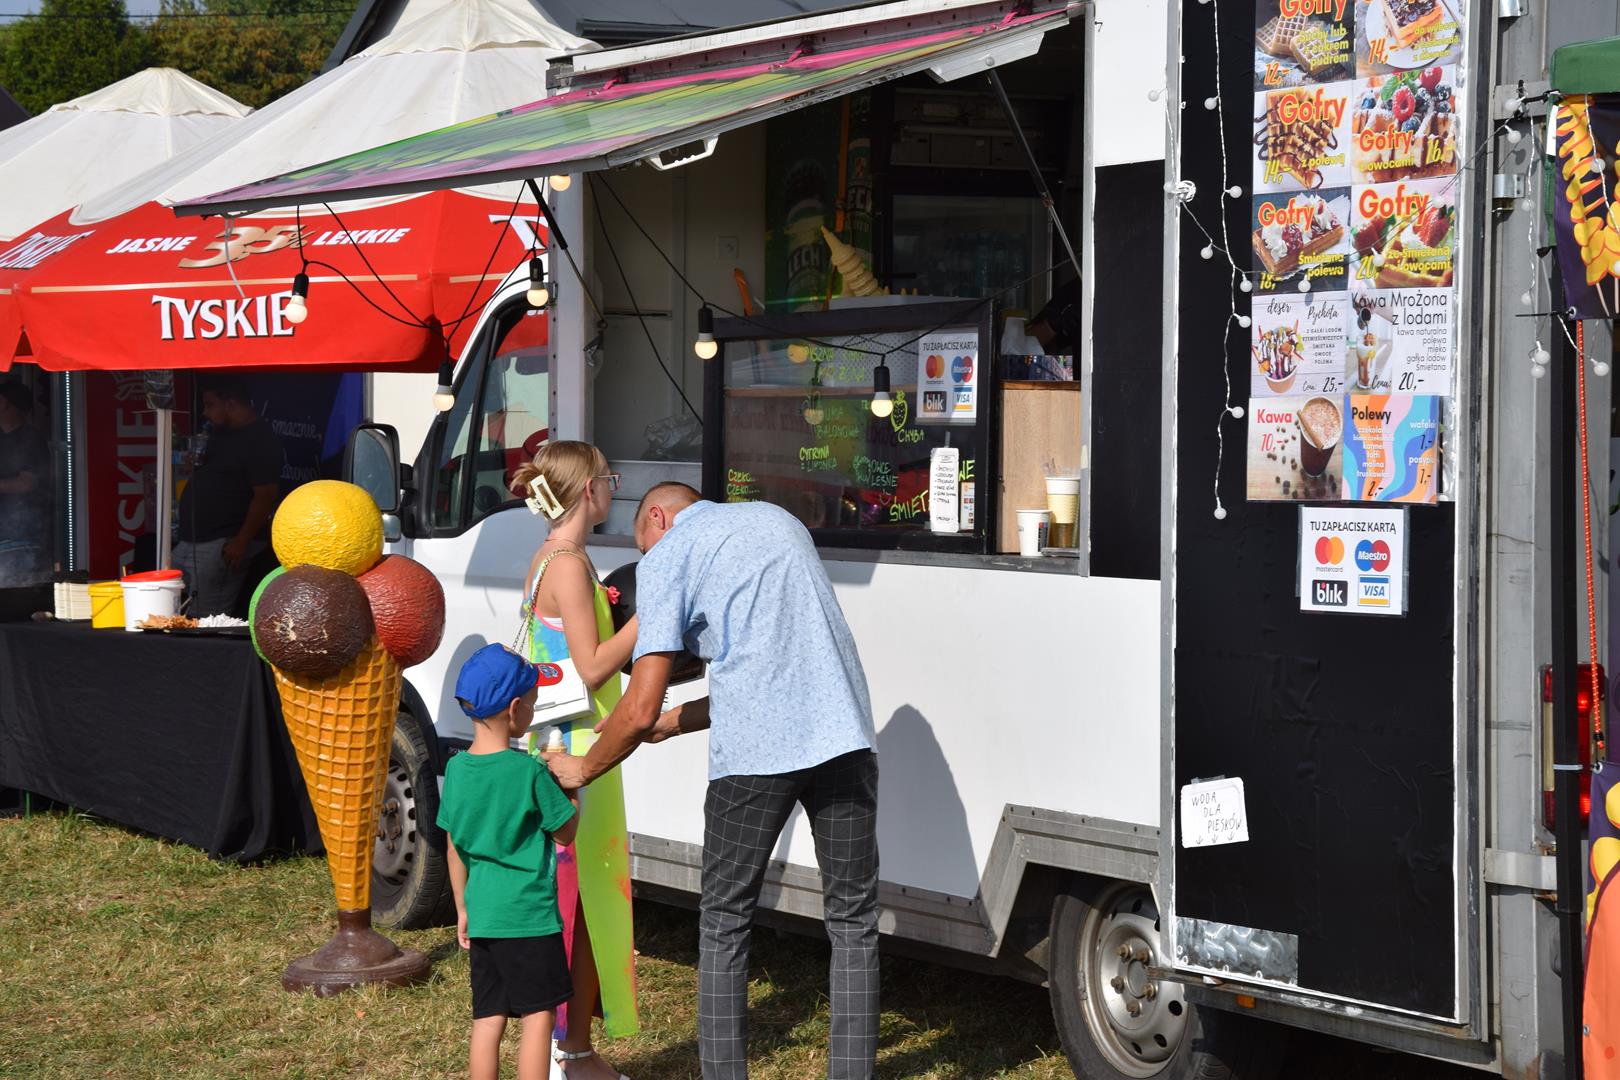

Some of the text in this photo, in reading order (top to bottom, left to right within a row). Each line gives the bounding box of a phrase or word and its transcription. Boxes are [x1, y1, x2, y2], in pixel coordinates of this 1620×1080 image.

[1331, 23, 1347, 37] lub
[1312, 40, 1349, 53] cukrem
[1368, 37, 1400, 64] 14,-
[1310, 53, 1349, 71] pudrem
[1278, 88, 1347, 128] Gofry
[1359, 123, 1414, 155] Gofry
[1368, 156, 1414, 171] owocami
[1263, 160, 1292, 184] 14,-
[1359, 184, 1430, 226] Gofry
[1258, 197, 1315, 232] Gofry
[106, 235, 198, 254] JASNE
[311, 227, 411, 246] LEKKIE
[1308, 265, 1344, 280] polewa
[1403, 260, 1453, 271] owocami
[1351, 292, 1386, 308] Kawa
[152, 290, 295, 341] TYSKIE
[1307, 301, 1338, 325] Pychota
[1391, 307, 1447, 326] z lodami
[1396, 327, 1447, 336] kawa naturalna
[923, 342, 931, 351] TU
[931, 341, 959, 351] ZAPŁACISZ
[1422, 336, 1447, 347] polewa
[1427, 343, 1447, 353] mleko
[1322, 376, 1344, 393] 25,-
[1398, 371, 1425, 392] 20,-
[926, 393, 944, 411] blik
[956, 393, 970, 403] VISA
[1257, 408, 1292, 424] Kawa
[1351, 405, 1392, 425] Polewy
[897, 428, 925, 443] CHYBA
[799, 445, 829, 461] CYTRYNA
[1367, 480, 1384, 497] 2,-
[1310, 521, 1397, 534] TU ZAPŁACISZ KARTĄ
[1357, 550, 1388, 561] Maestro
[1316, 582, 1343, 604] blik
[1363, 585, 1385, 597] VISA
[1192, 791, 1217, 807] WODA
[1203, 803, 1221, 818] DLA
[1207, 812, 1242, 834] PIESKÓW
